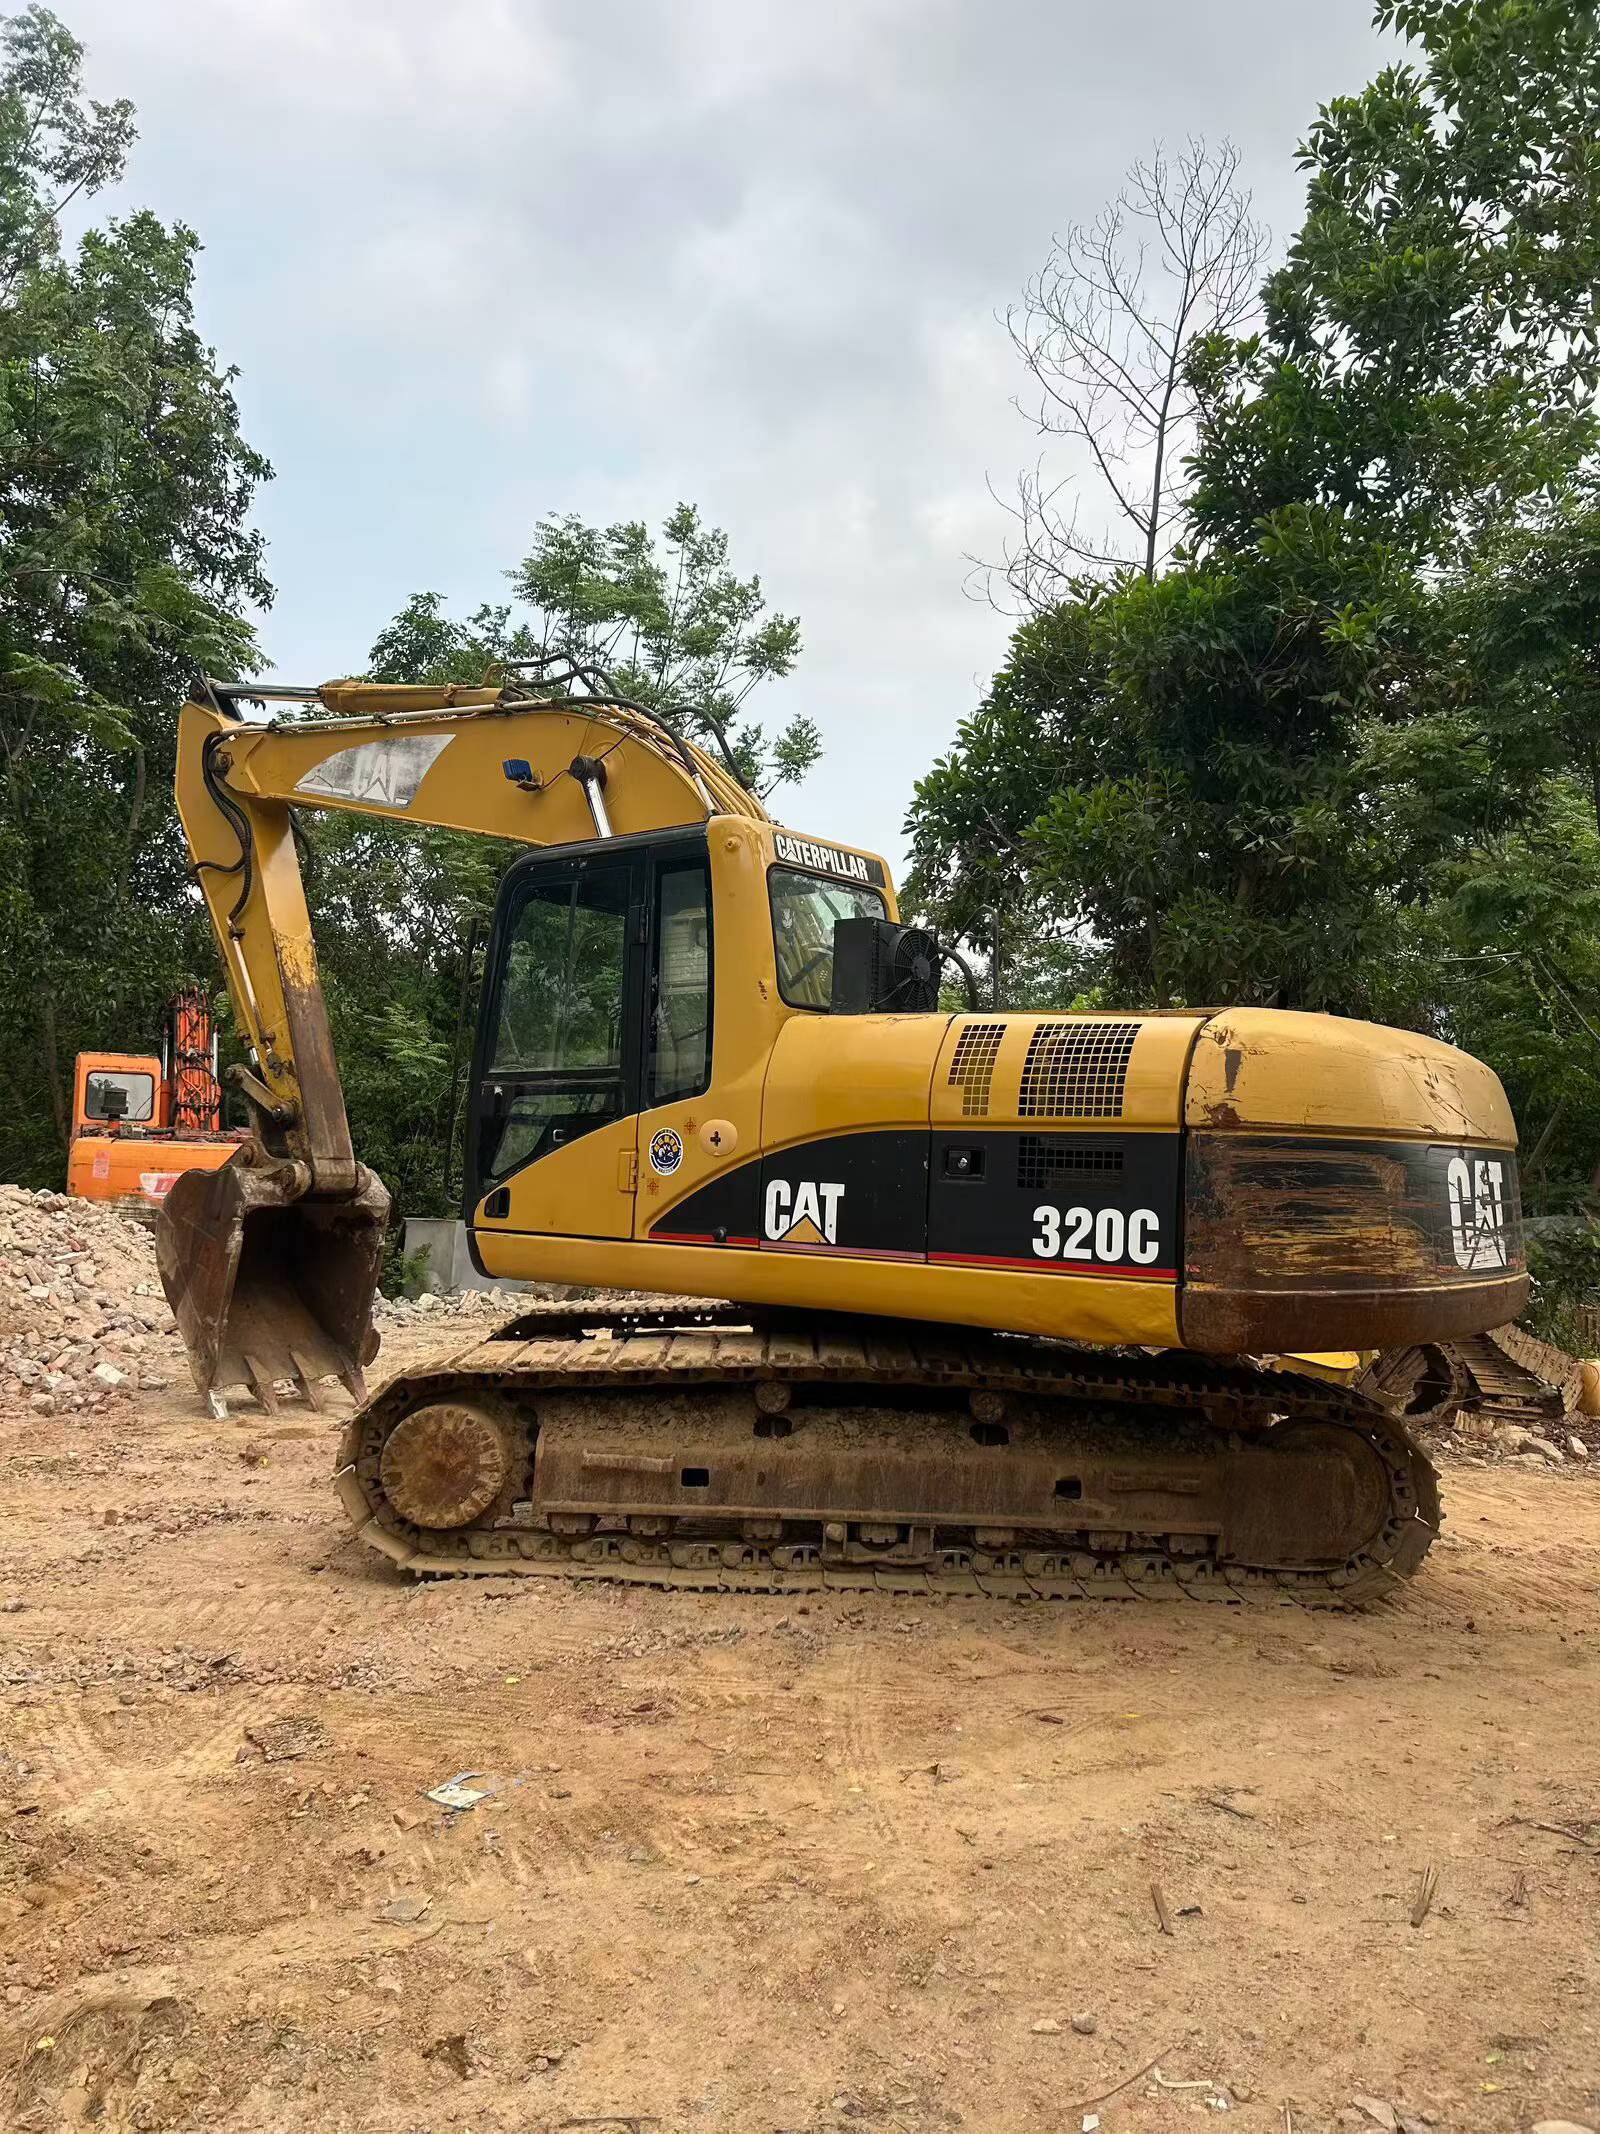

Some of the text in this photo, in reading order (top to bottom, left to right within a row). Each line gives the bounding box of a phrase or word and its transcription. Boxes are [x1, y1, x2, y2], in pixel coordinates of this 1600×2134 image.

[775, 834, 869, 881] CATERPILLAR
[764, 1179, 846, 1244] CAT
[1032, 1205, 1160, 1264] 320C
[1447, 1157, 1507, 1270] CAT
